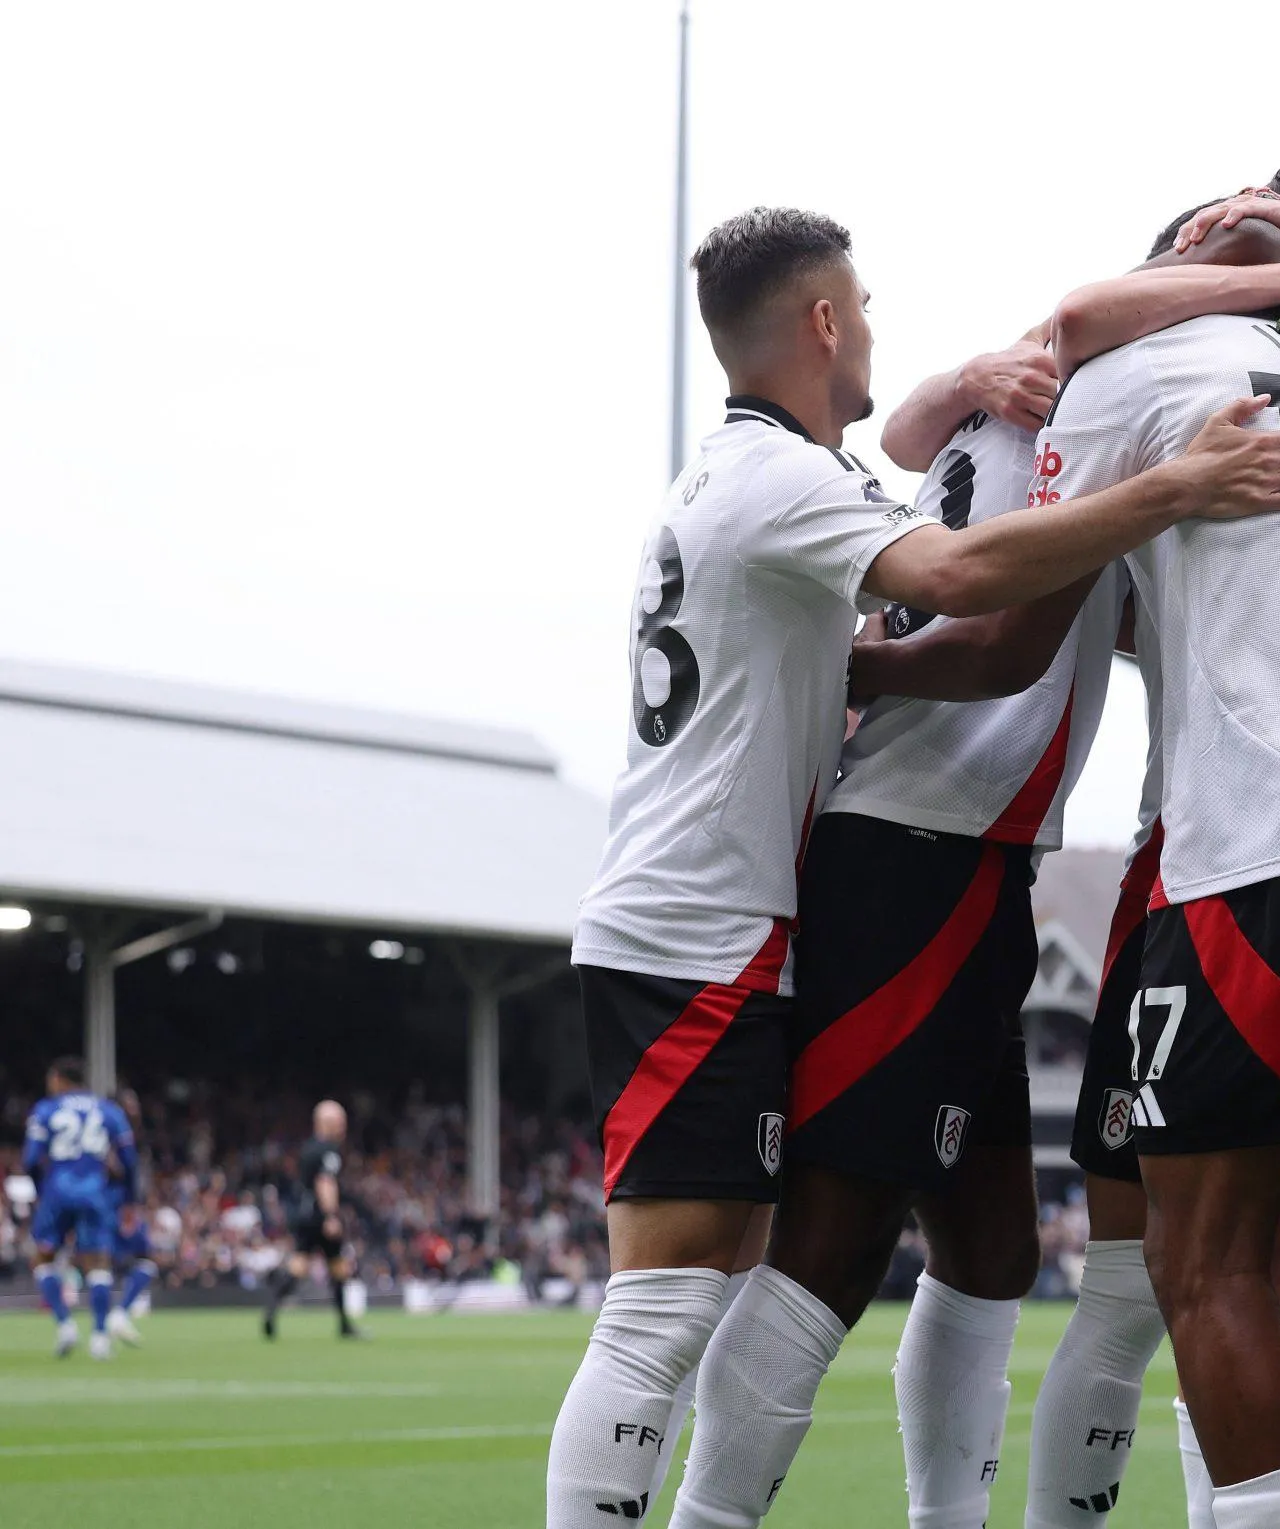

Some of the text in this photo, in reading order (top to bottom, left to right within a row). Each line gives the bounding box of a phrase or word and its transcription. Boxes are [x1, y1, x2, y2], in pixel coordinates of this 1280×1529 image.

[632, 525, 701, 748] 8
[1127, 985, 1188, 1082] 17
[1107, 1097, 1130, 1139] FFC
